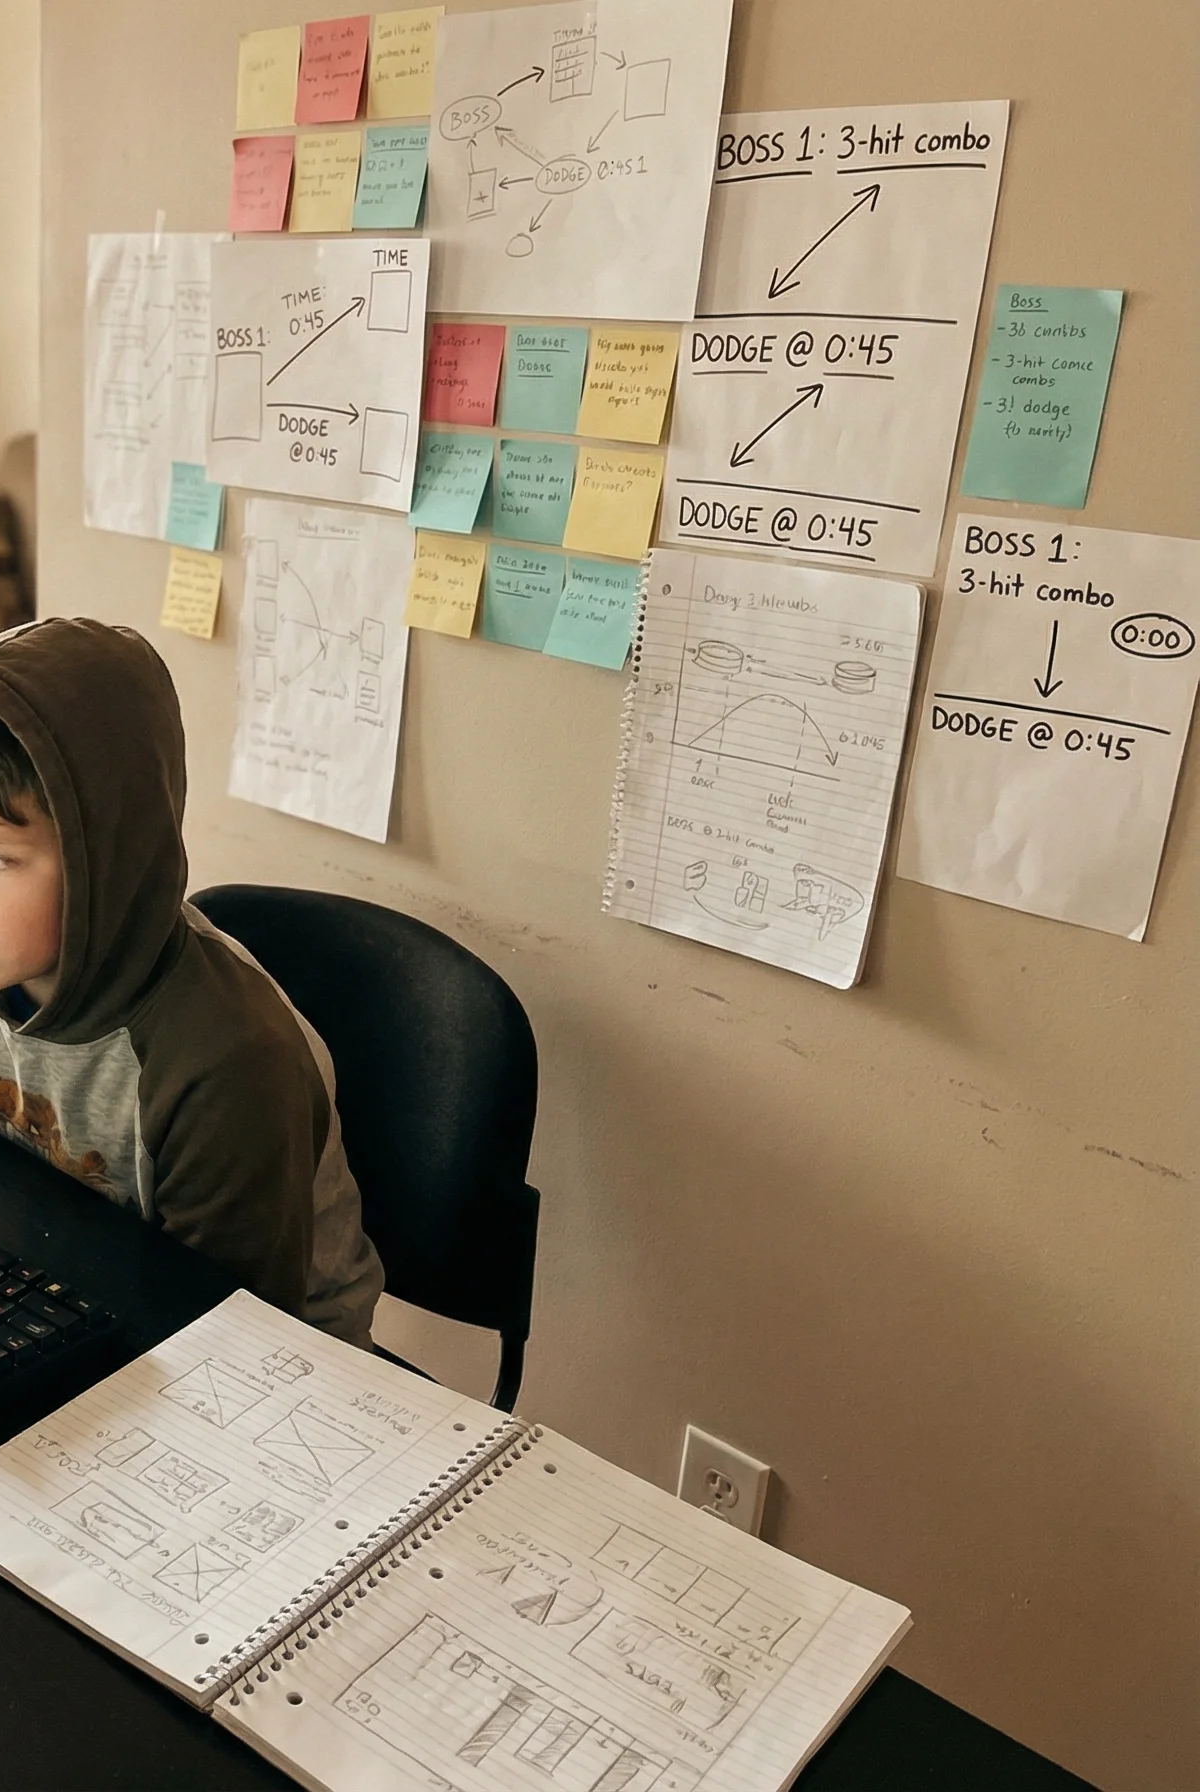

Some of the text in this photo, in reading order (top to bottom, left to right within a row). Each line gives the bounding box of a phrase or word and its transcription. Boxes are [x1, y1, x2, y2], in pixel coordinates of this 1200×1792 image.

[451, 105, 491, 131] BOSS
[718, 121, 990, 169] BOSS 1: 3-hit combo
[545, 166, 585, 185] DODGE
[373, 249, 409, 266] TIME
[289, 310, 325, 335] 0:45
[217, 328, 251, 349] BOSS
[691, 331, 899, 367] DODGE @ 0:45
[1023, 399, 1070, 420] dodge
[279, 414, 329, 436] DODGE
[679, 496, 878, 546] DODGE @ 0:45
[965, 526, 1081, 563] BOSS 1:
[958, 568, 1114, 608] 3-hit combo
[1121, 624, 1180, 649] 0:00
[932, 705, 1135, 760] DODGE @ 0:45
